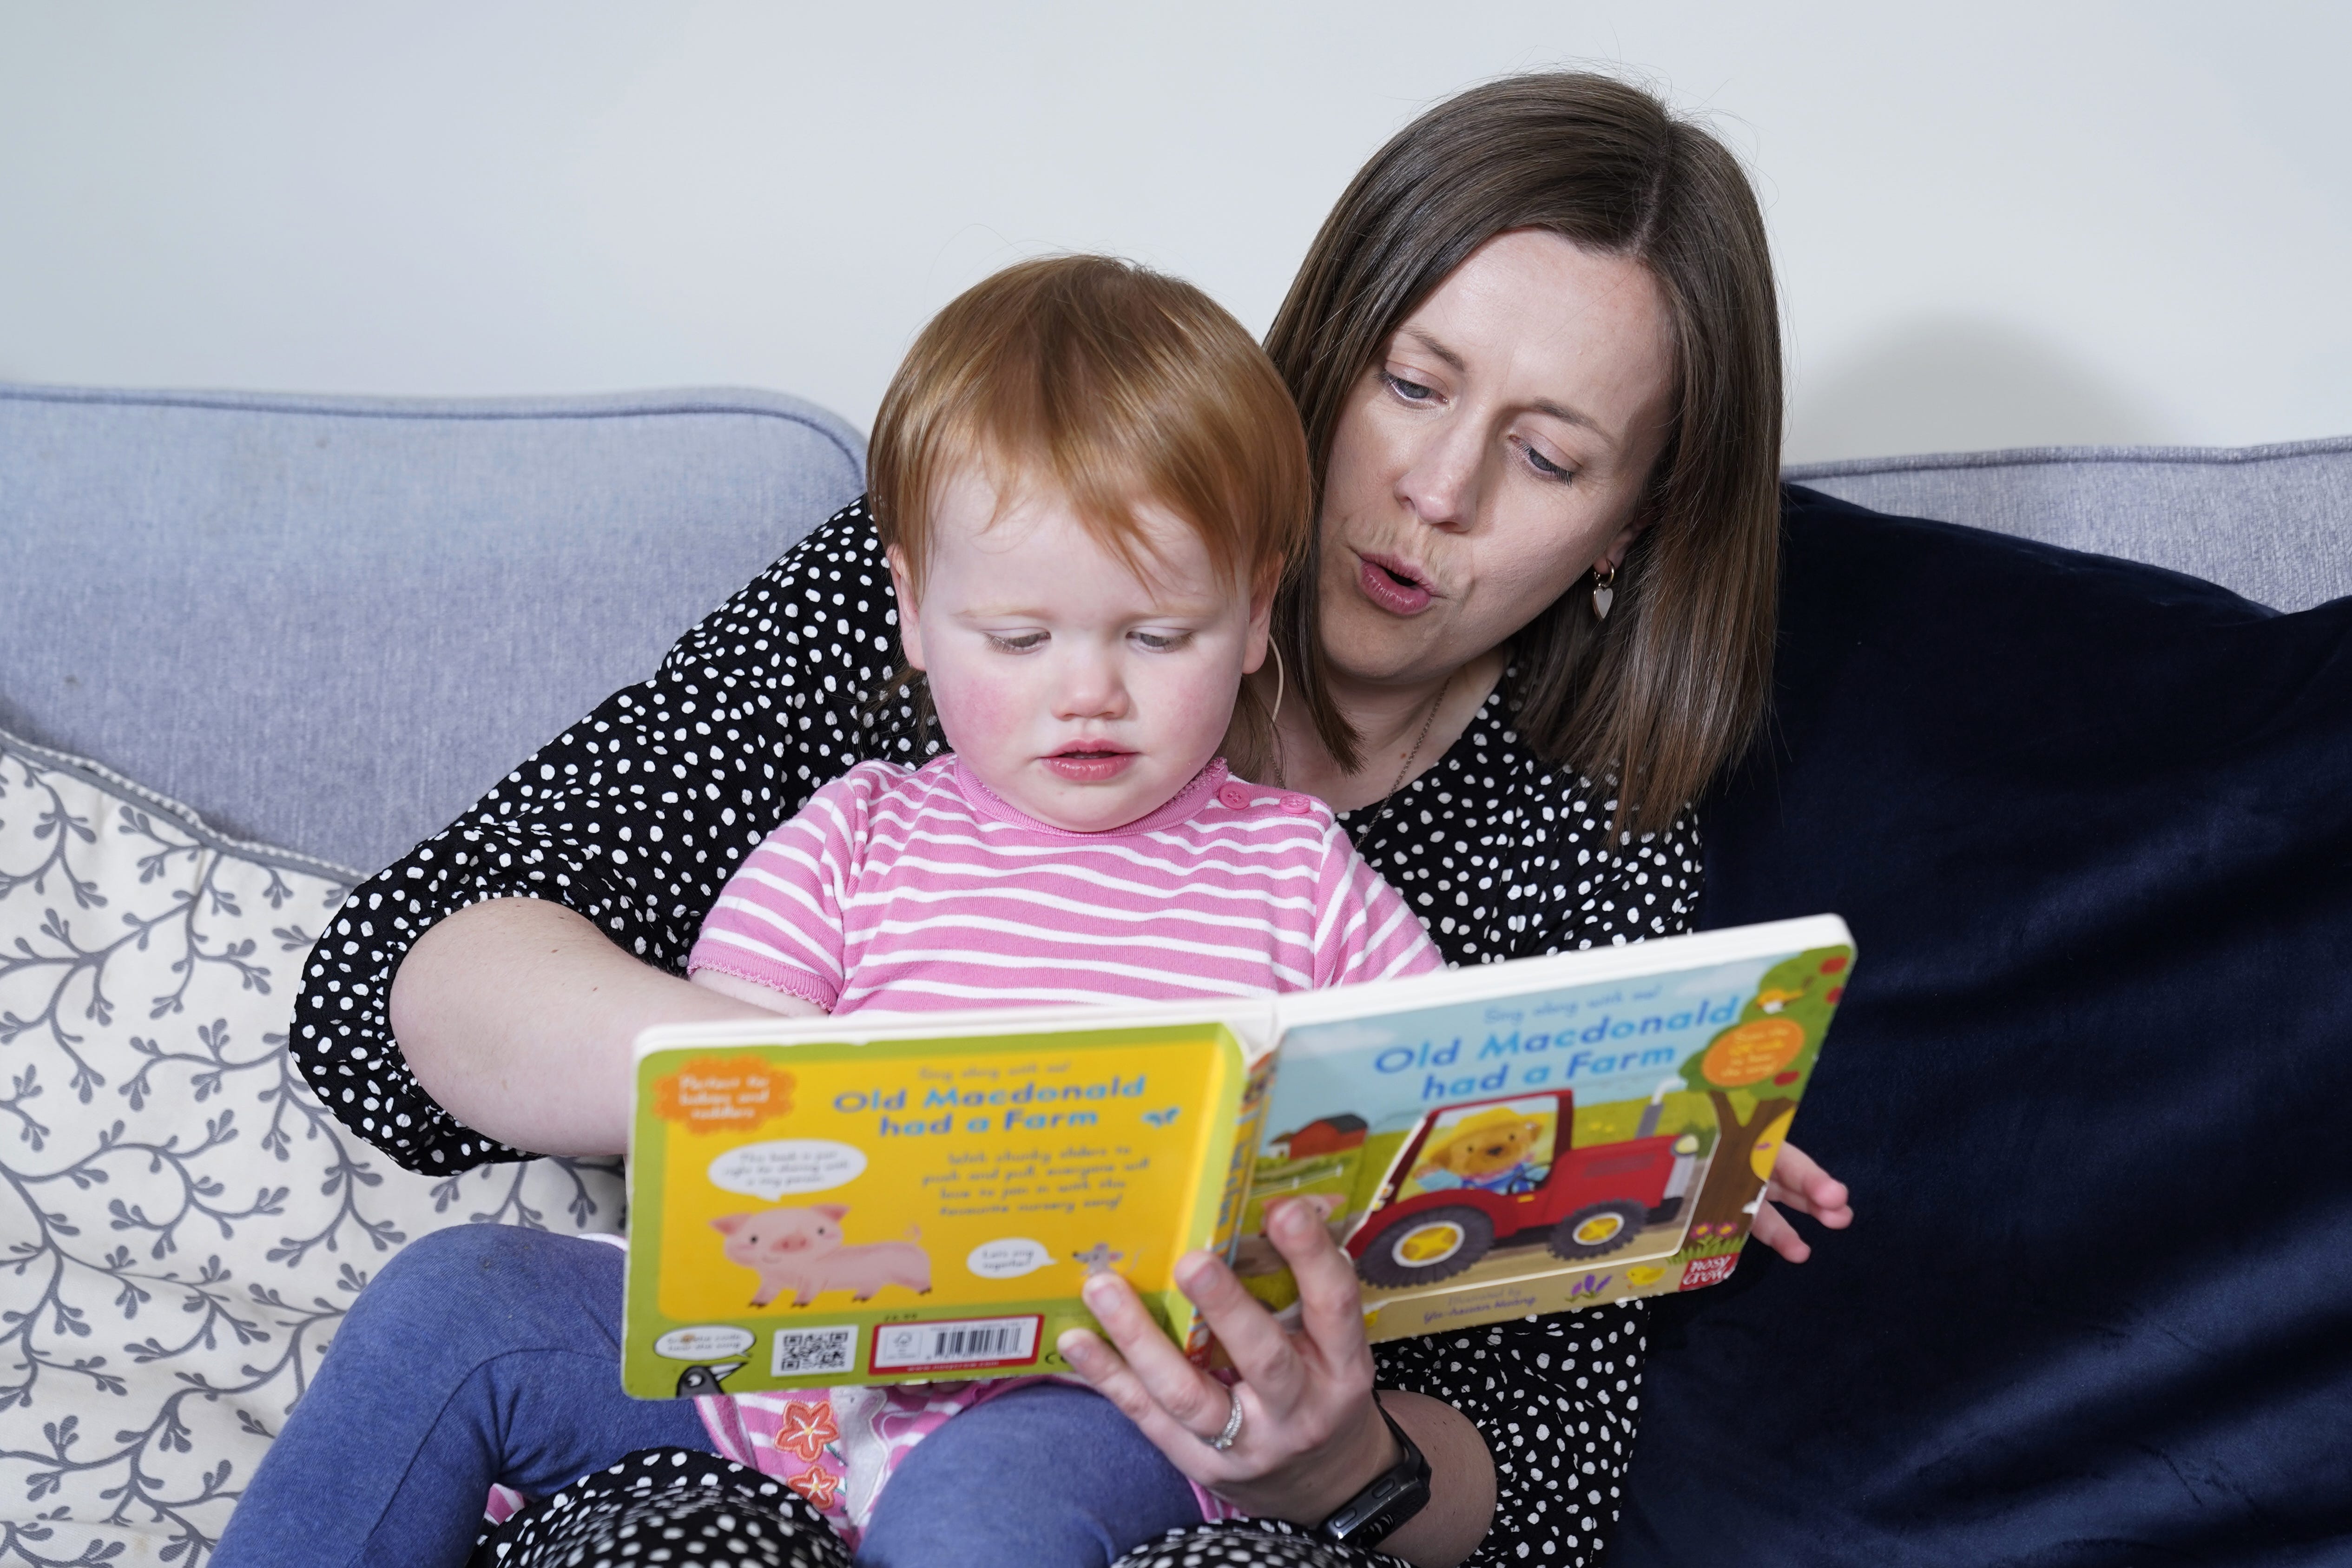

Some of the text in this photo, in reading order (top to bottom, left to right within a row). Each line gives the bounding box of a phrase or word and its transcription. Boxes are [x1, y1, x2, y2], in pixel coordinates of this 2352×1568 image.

[1534, 1001, 1577, 1018] along
[1587, 991, 1622, 1008] with
[1374, 995, 1739, 1074] Old Macdonald
[833, 1074, 1146, 1114] Old Macdonald
[1422, 1047, 1675, 1101] had a Farm
[878, 1108, 1099, 1138] had a Farm
